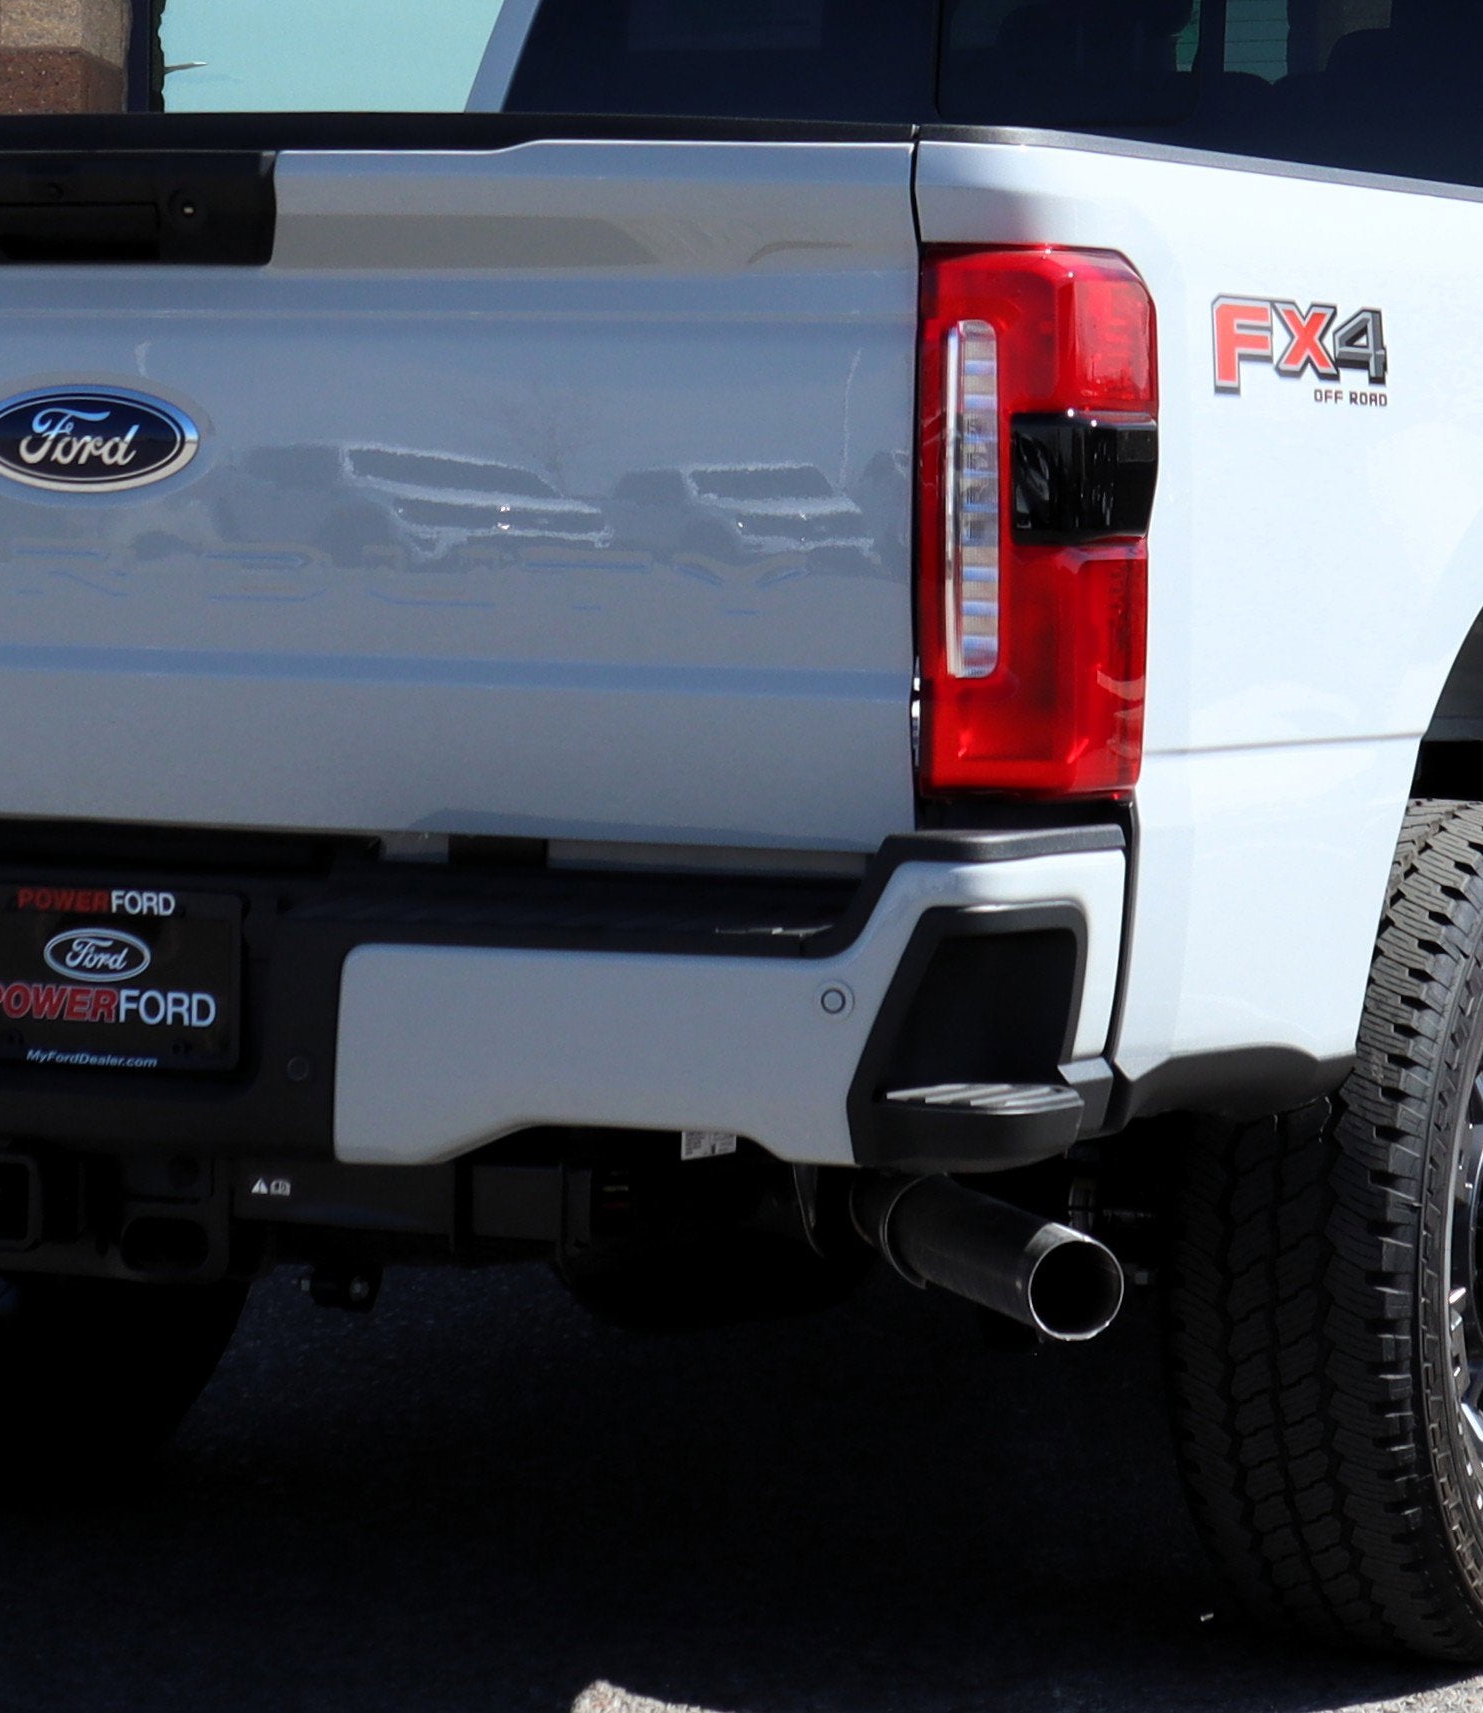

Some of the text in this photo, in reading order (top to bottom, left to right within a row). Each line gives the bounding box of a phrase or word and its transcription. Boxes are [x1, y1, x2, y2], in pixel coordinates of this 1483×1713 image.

[1211, 294, 1387, 395] FX4
[1314, 389, 1388, 407] OFF ROAD
[20, 408, 139, 466] Ford
[65, 938, 127, 970] Ford
[26, 1049, 157, 1068] MyFordDealer.com
